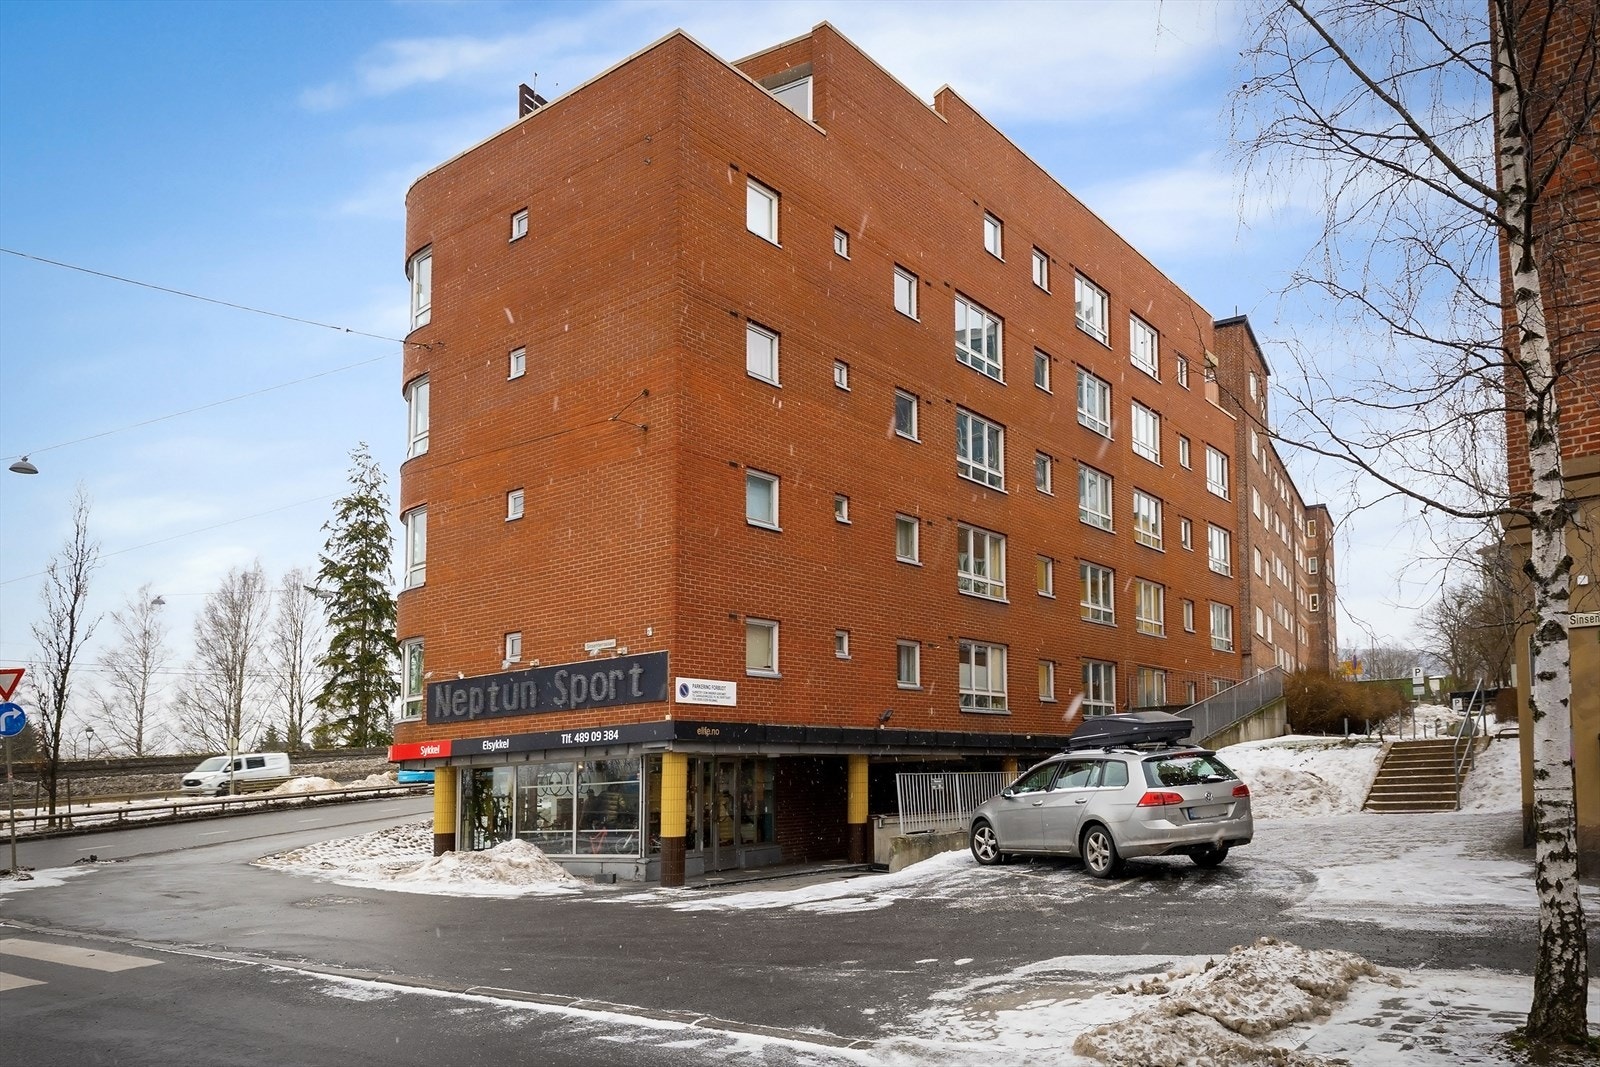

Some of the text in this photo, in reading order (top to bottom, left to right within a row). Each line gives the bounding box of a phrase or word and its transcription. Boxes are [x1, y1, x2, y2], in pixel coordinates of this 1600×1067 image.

[1415, 668, 1421, 677] P
[435, 663, 644, 719] Neptun Sport
[561, 729, 619, 745] Tlf. 489 09 384
[420, 744, 440, 757] Sykkel
[482, 738, 510, 752] Elsykkel
